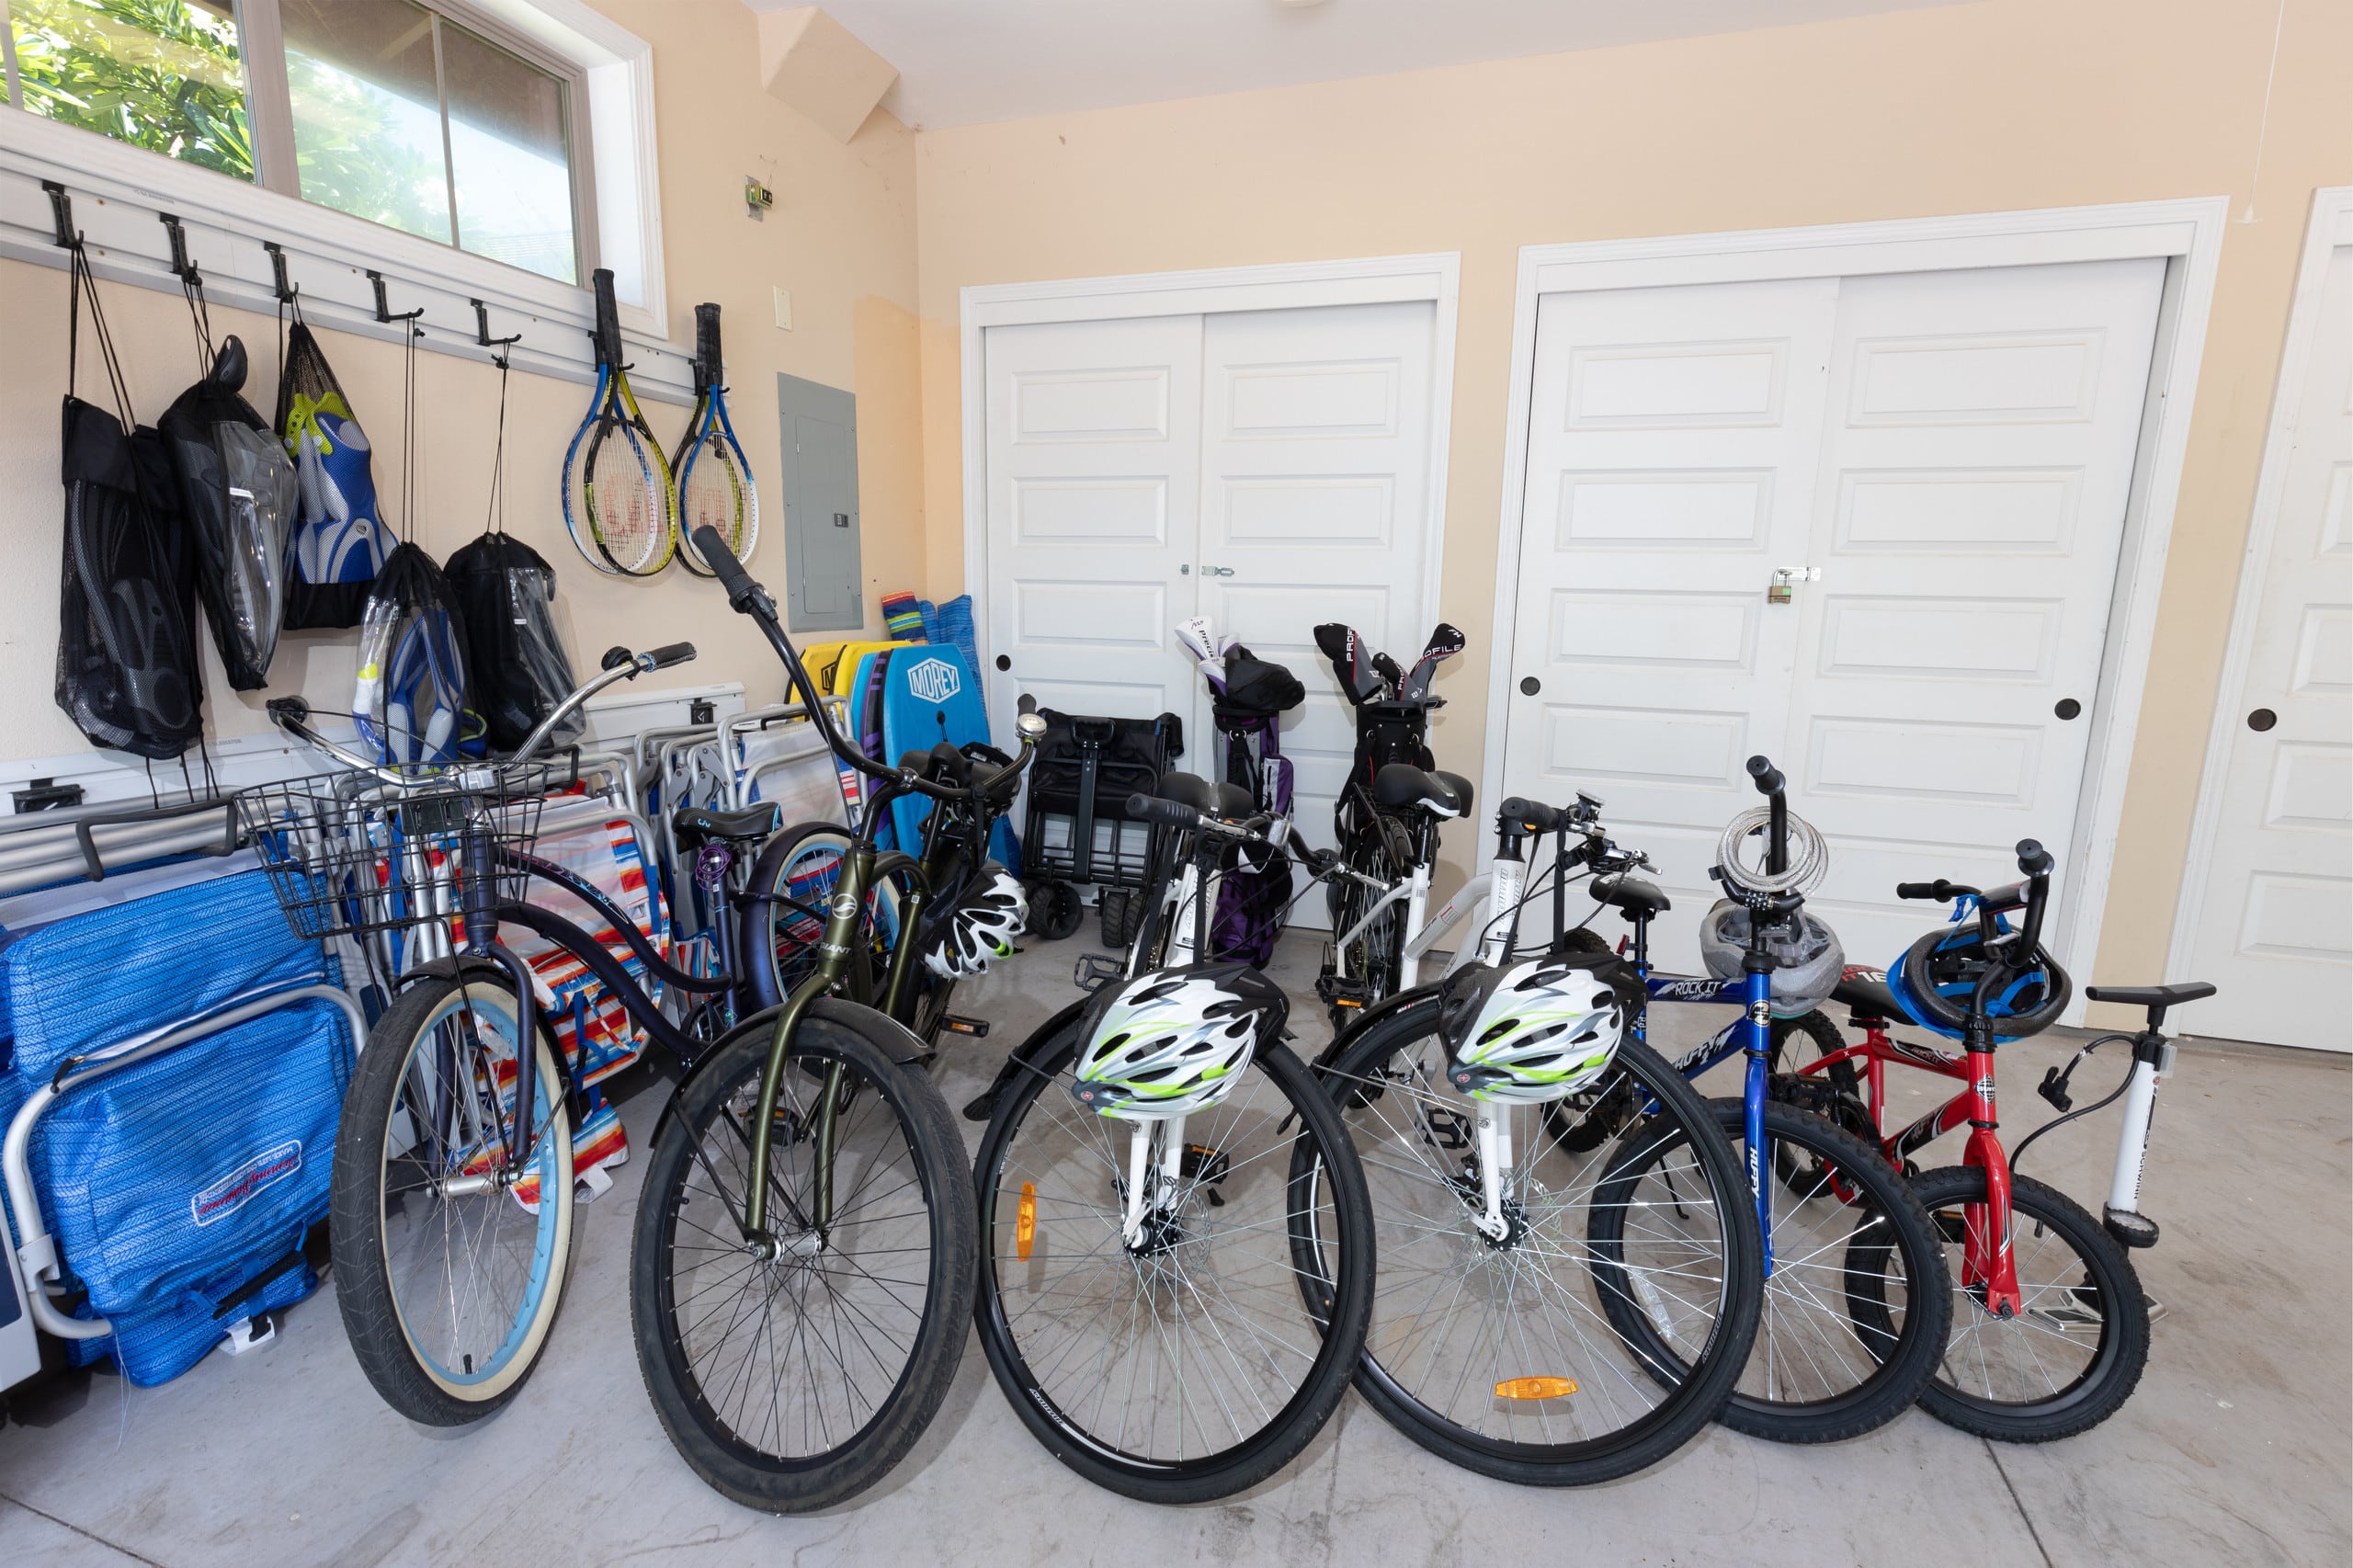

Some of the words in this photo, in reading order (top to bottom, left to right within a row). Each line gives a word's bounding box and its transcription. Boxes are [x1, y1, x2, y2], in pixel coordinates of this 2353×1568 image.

[1198, 630, 1214, 658] Precis
[1346, 627, 1356, 662] PROF
[1424, 643, 1462, 658] OFILE
[911, 662, 956, 699] MOREY
[1675, 981, 1702, 996] ROCK
[1703, 981, 1722, 994] IT
[1675, 1035, 1718, 1070] HUFFY
[1749, 1146, 1760, 1199] HUFFY
